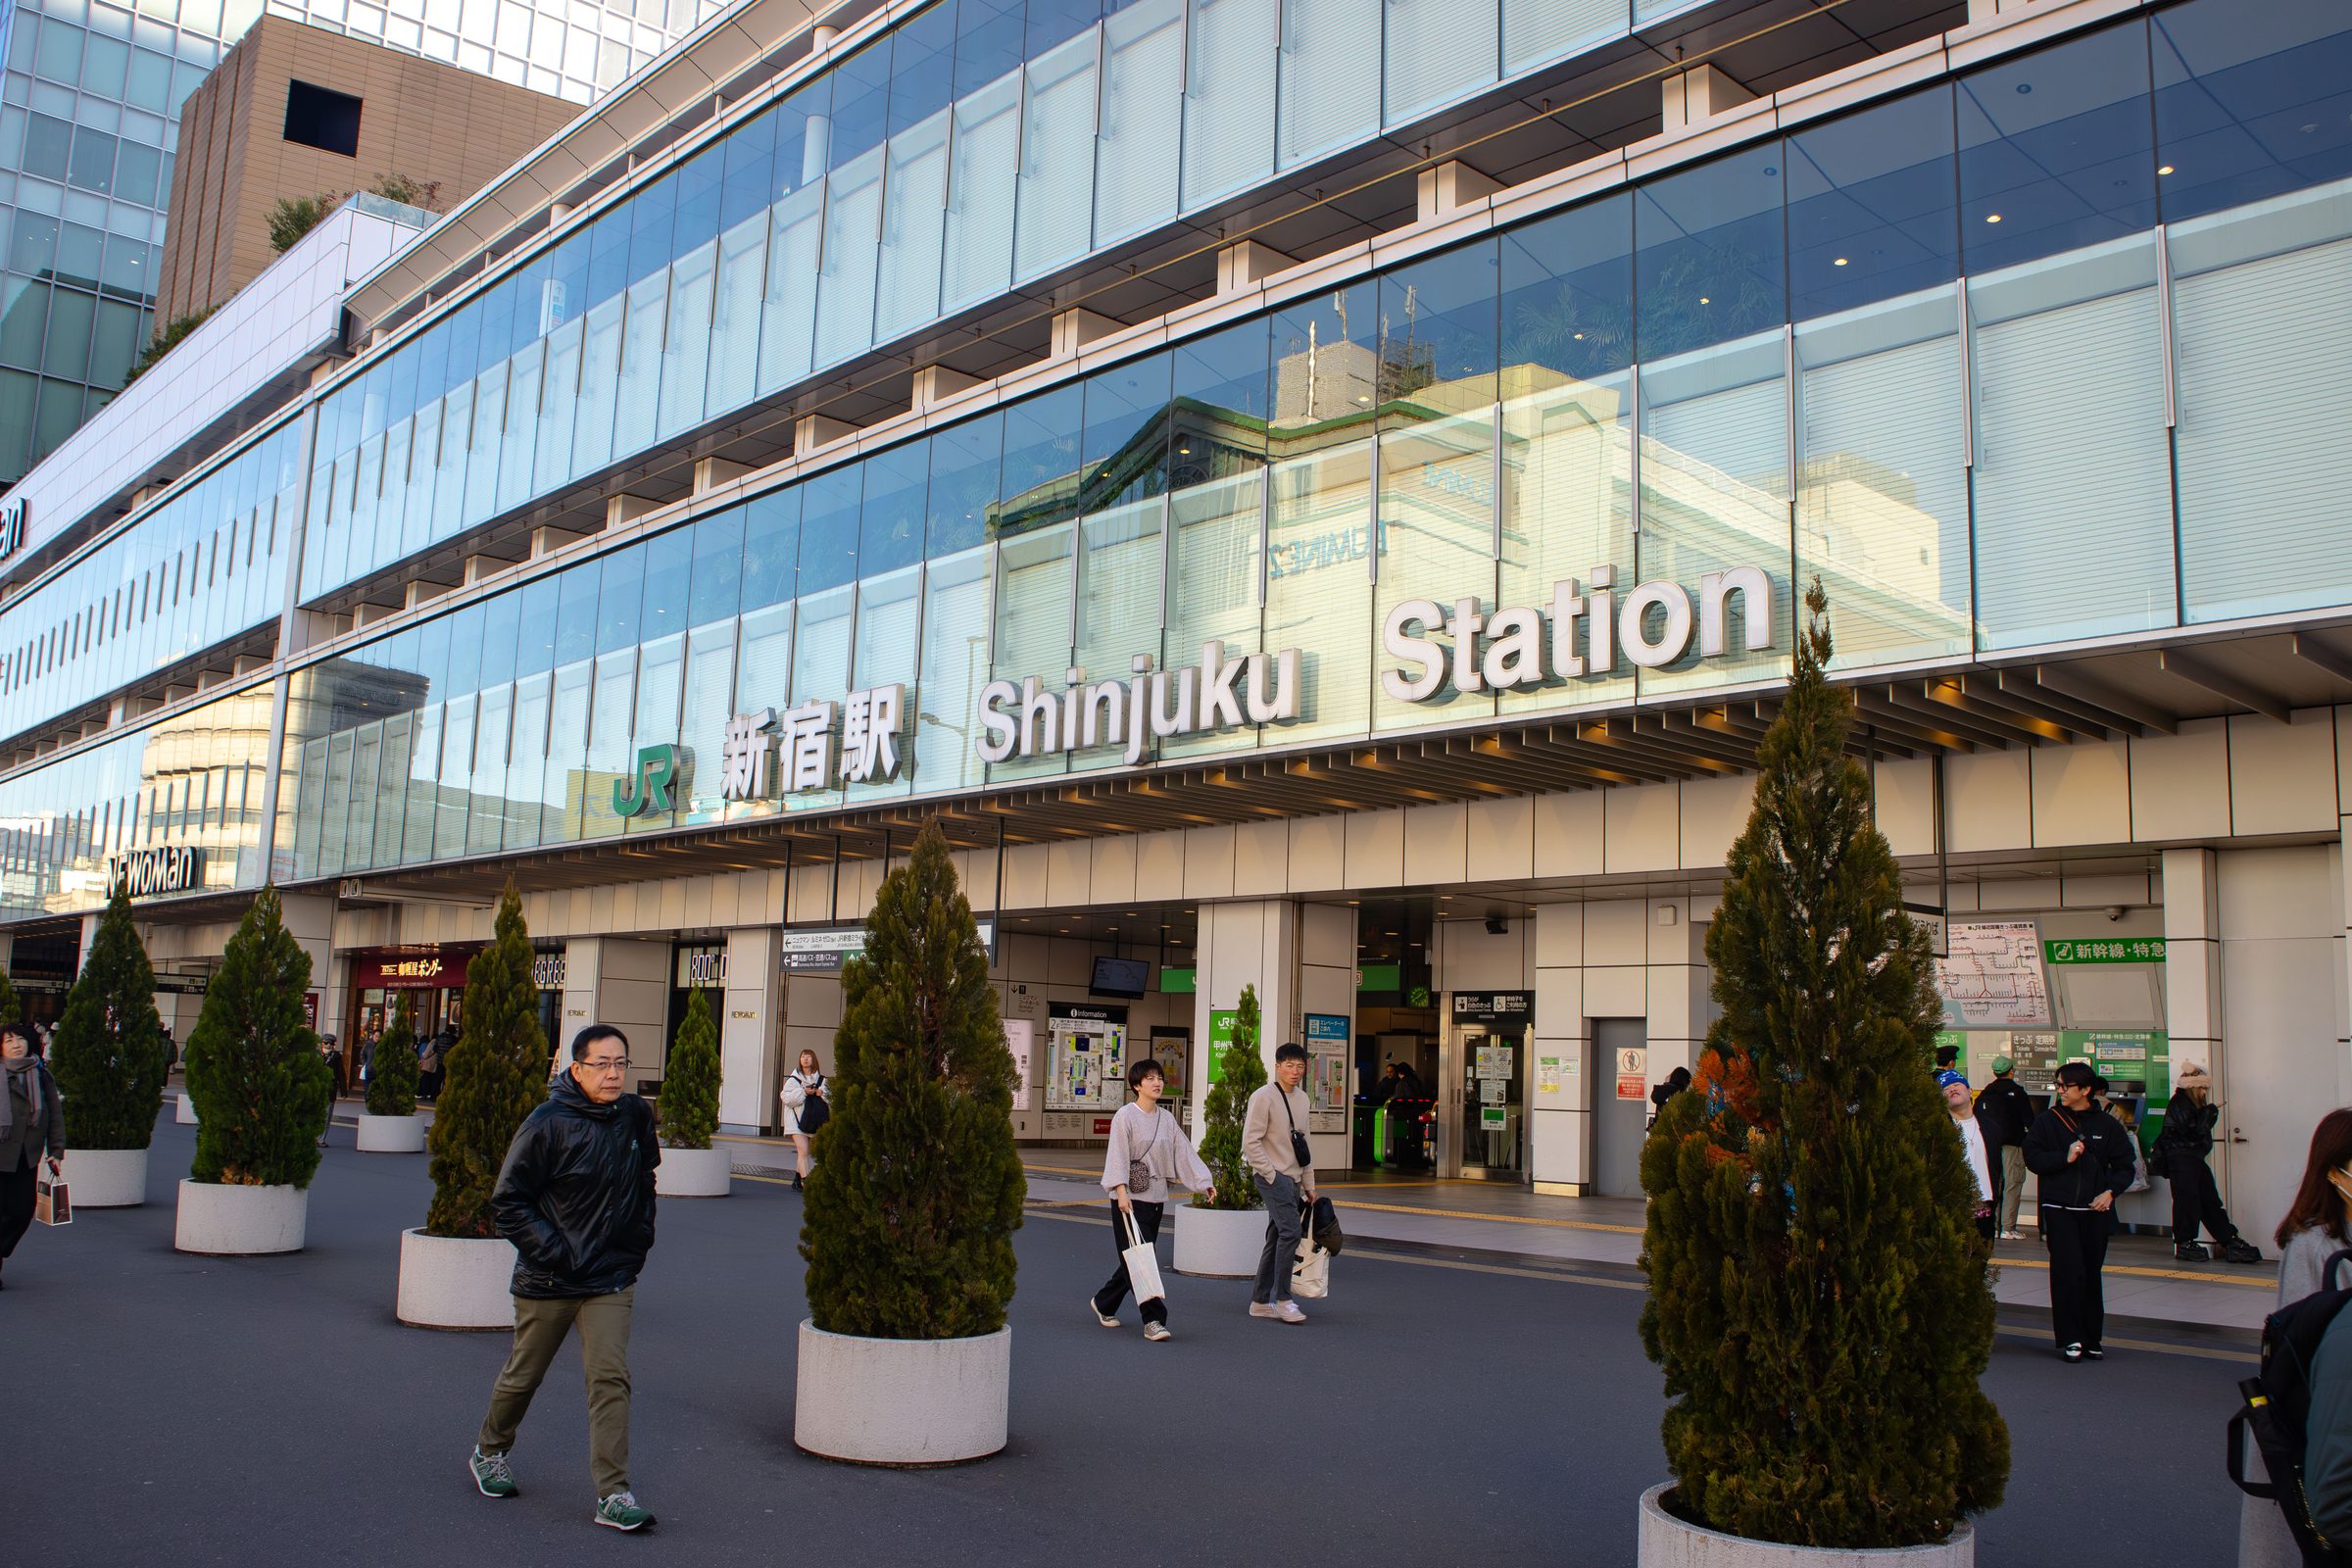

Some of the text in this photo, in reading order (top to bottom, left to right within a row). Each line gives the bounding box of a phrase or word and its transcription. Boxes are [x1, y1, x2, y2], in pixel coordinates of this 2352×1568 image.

[612, 563, 1776, 817] JR 新宿駅 Shinjuku Station
[2076, 941, 2166, 959] 新幹線・特急
[1078, 1009, 1107, 1018] Information
[1218, 1017, 1230, 1027] JR
[2013, 1035, 2033, 1045] きっぷ
